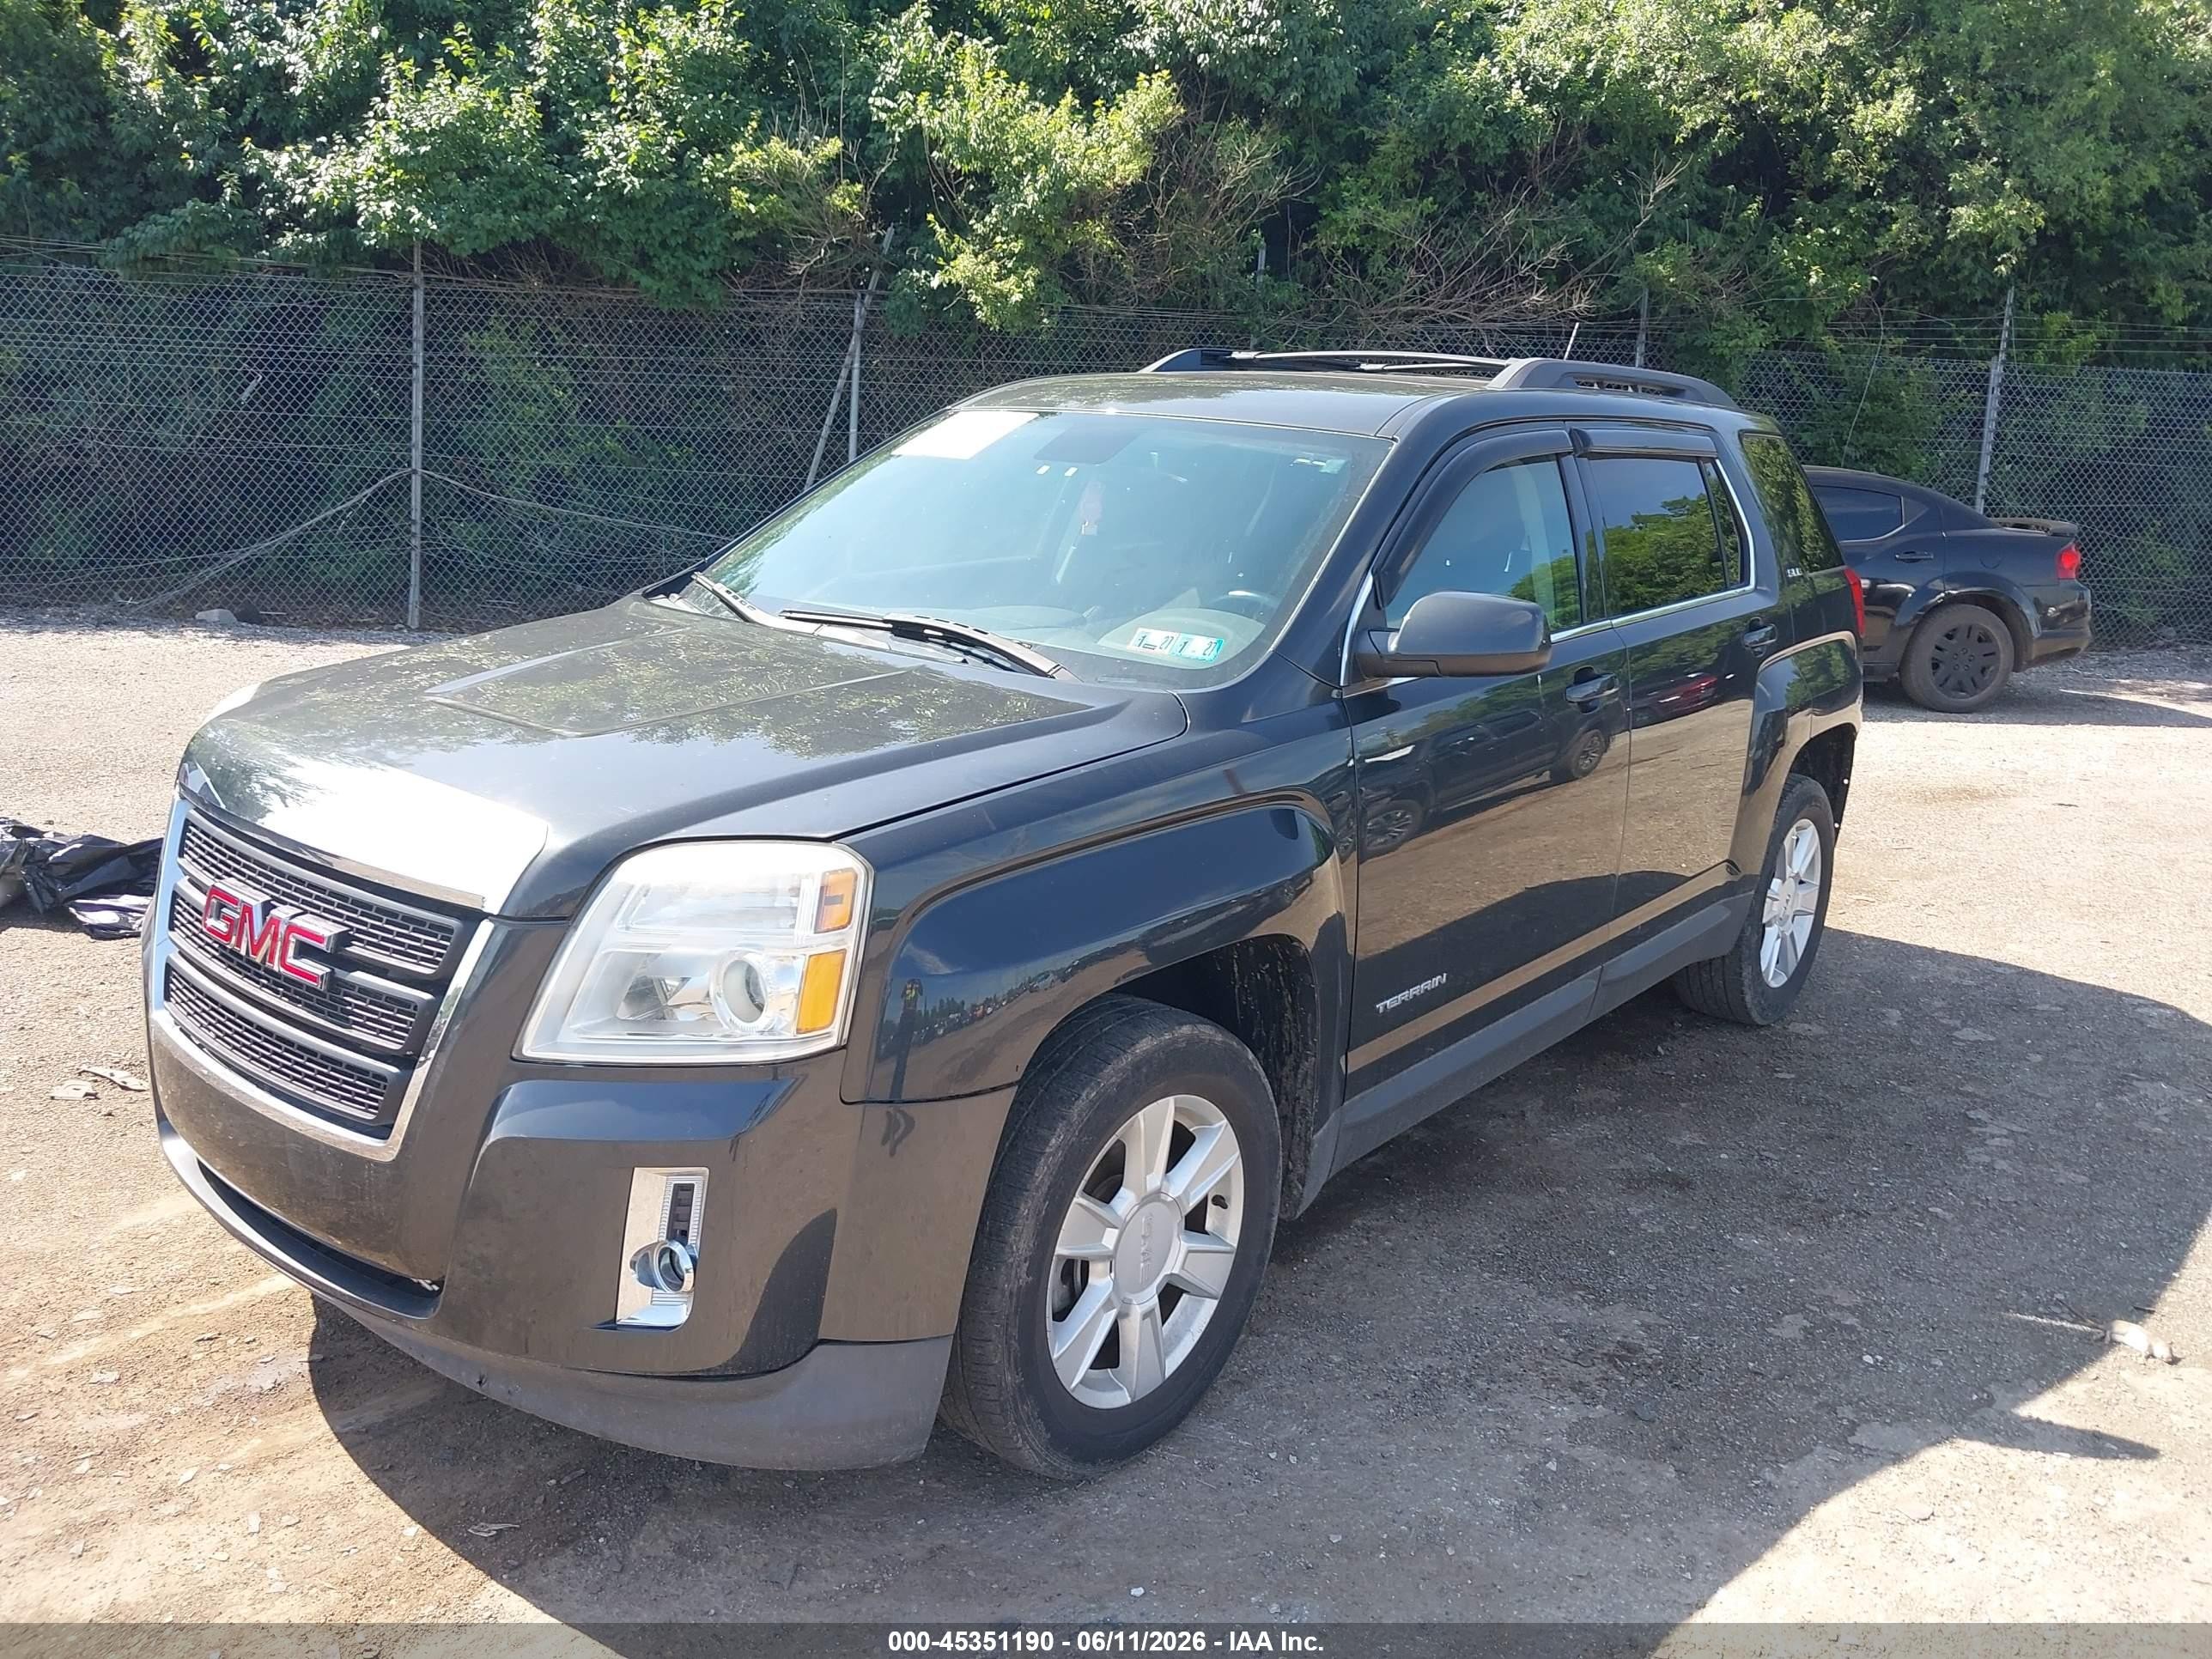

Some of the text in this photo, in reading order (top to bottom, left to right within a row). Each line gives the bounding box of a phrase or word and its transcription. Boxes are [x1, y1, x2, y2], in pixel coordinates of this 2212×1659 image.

[1203, 641, 1217, 656] 27
[202, 884, 331, 990] GMC
[1376, 972, 1447, 1014] TERRAIN
